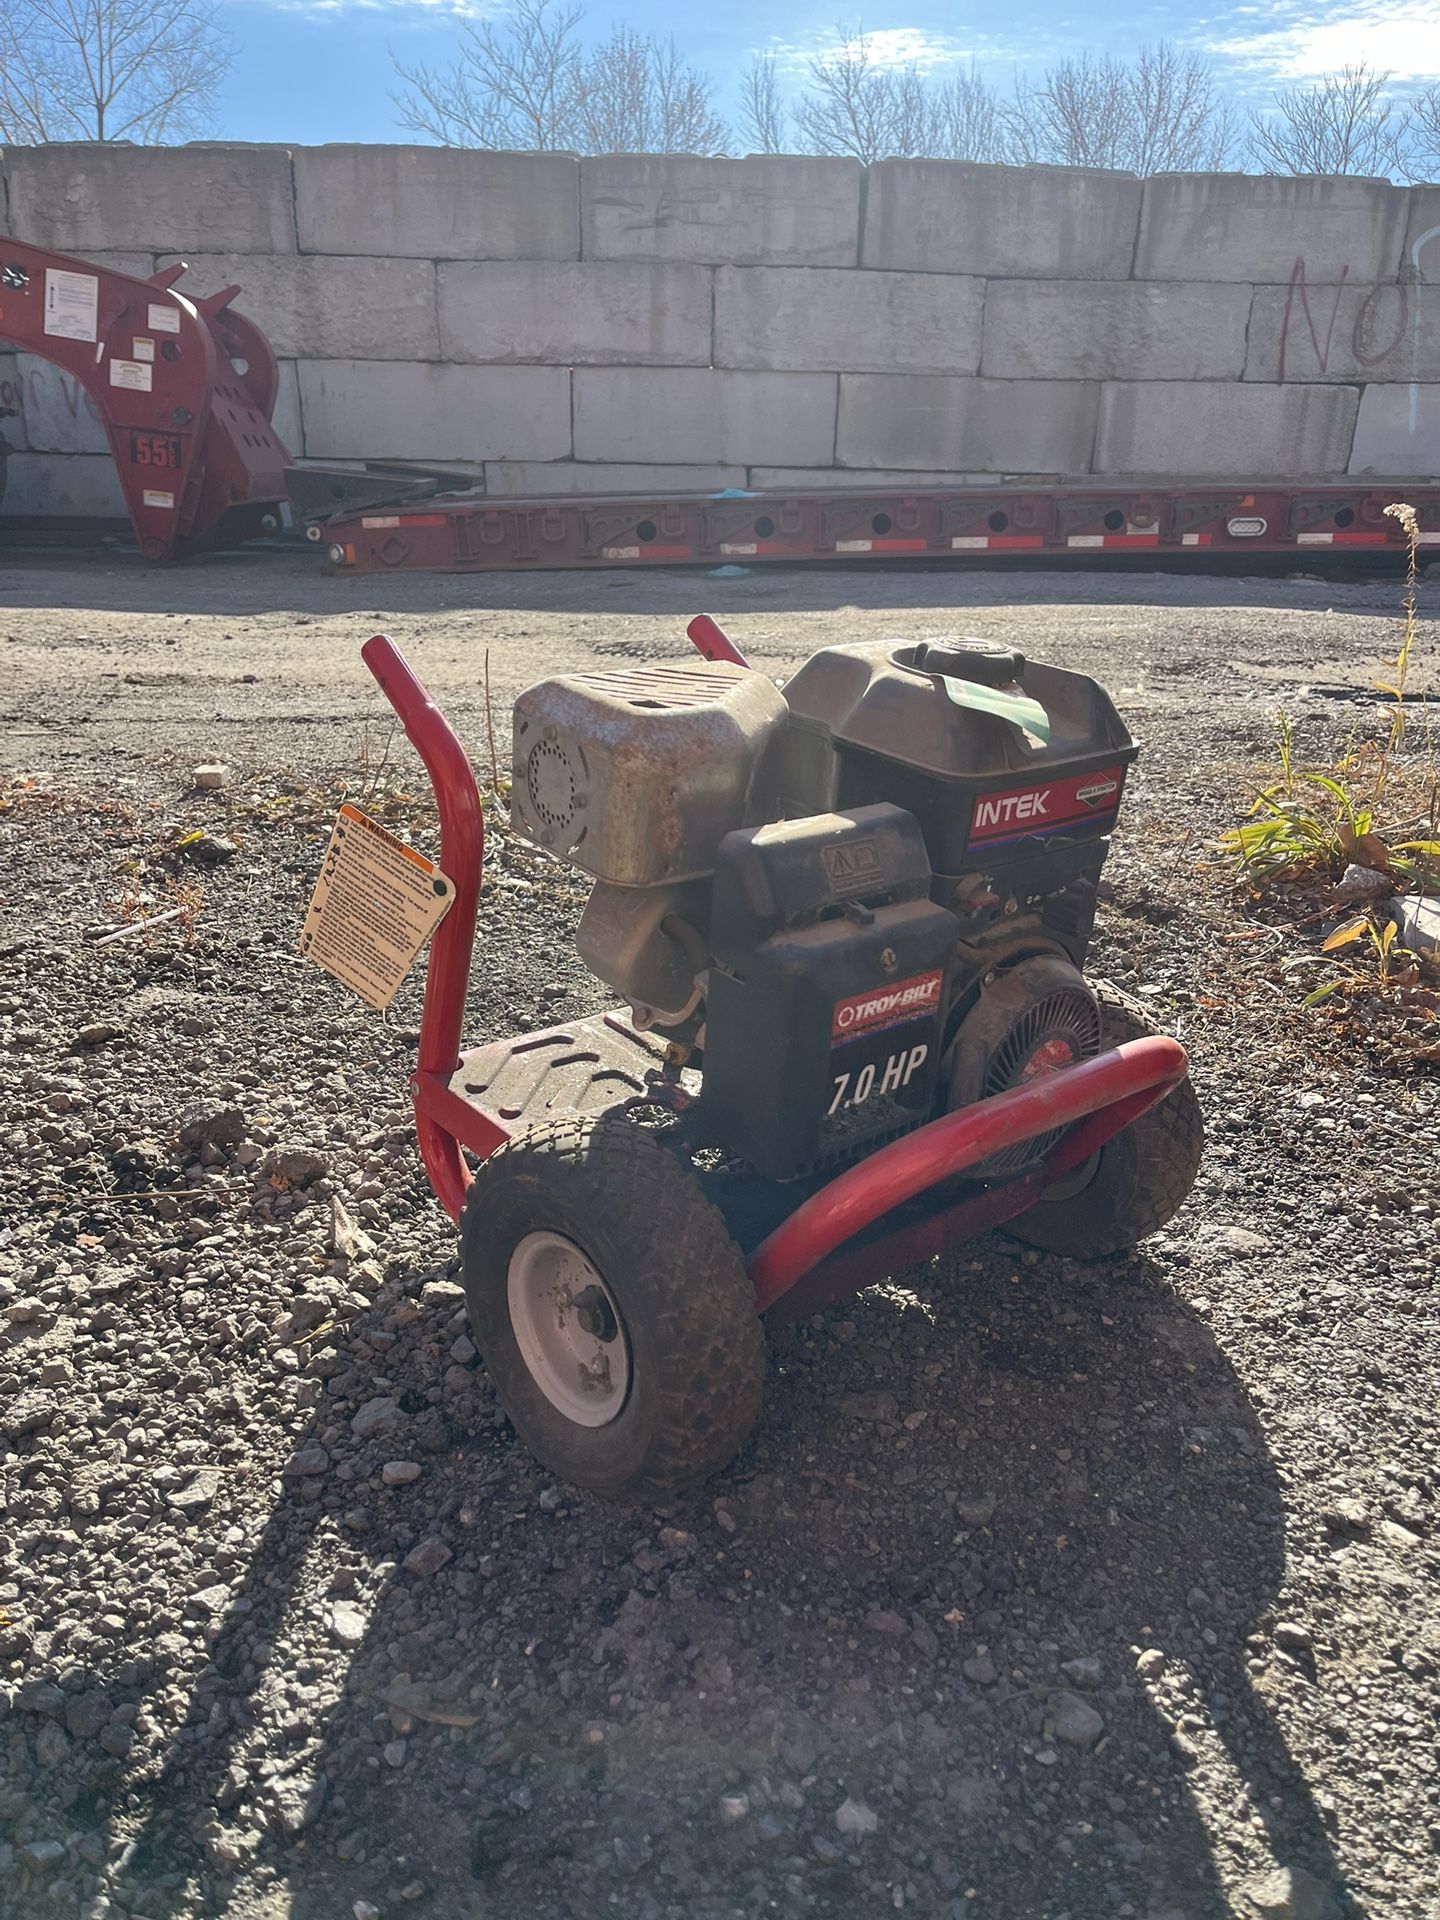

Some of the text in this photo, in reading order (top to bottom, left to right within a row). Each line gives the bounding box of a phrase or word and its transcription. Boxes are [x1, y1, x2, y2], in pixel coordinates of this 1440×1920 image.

[974, 789, 1052, 829] INTEK
[367, 820, 404, 853] WARNING
[827, 1043, 929, 1116] 7.0 HP
